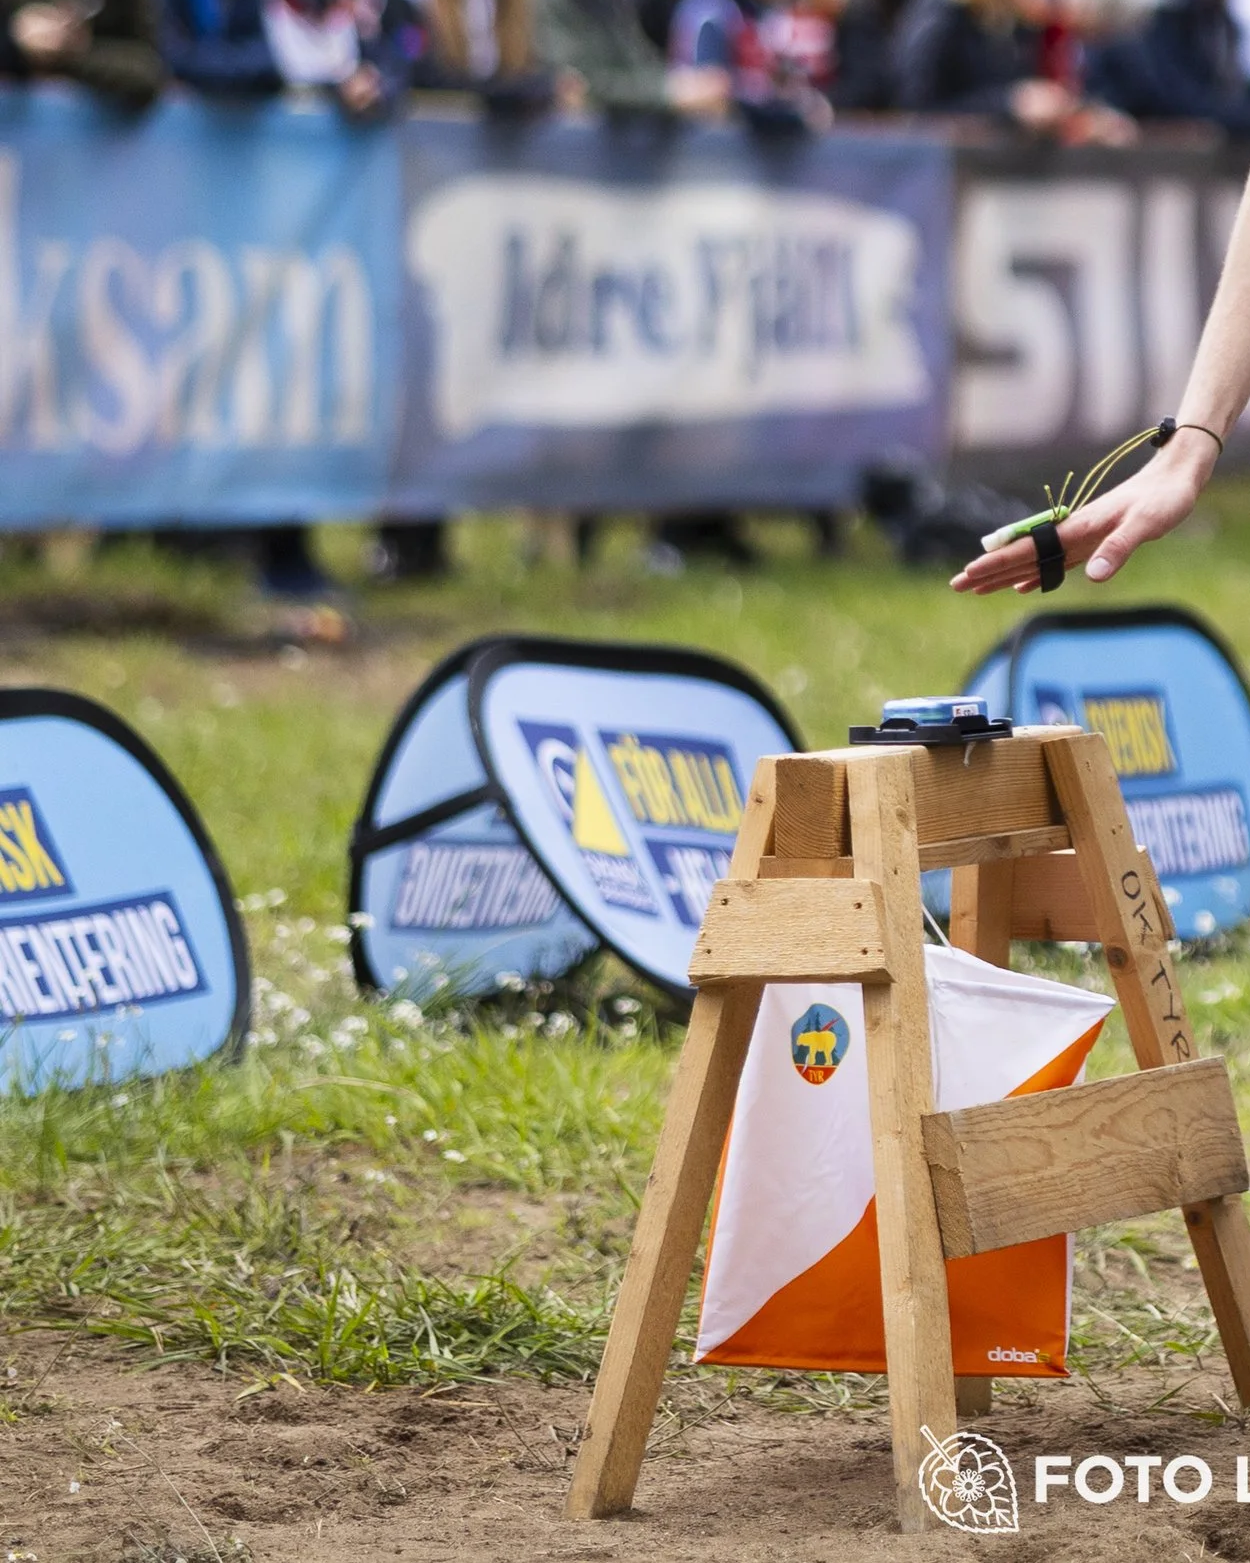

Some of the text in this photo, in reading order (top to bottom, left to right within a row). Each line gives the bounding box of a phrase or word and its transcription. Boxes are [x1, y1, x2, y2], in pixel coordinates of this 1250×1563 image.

[1126, 789, 1250, 876] IENTERING
[1120, 870, 1153, 945] OK
[807, 1069, 825, 1083] TYR
